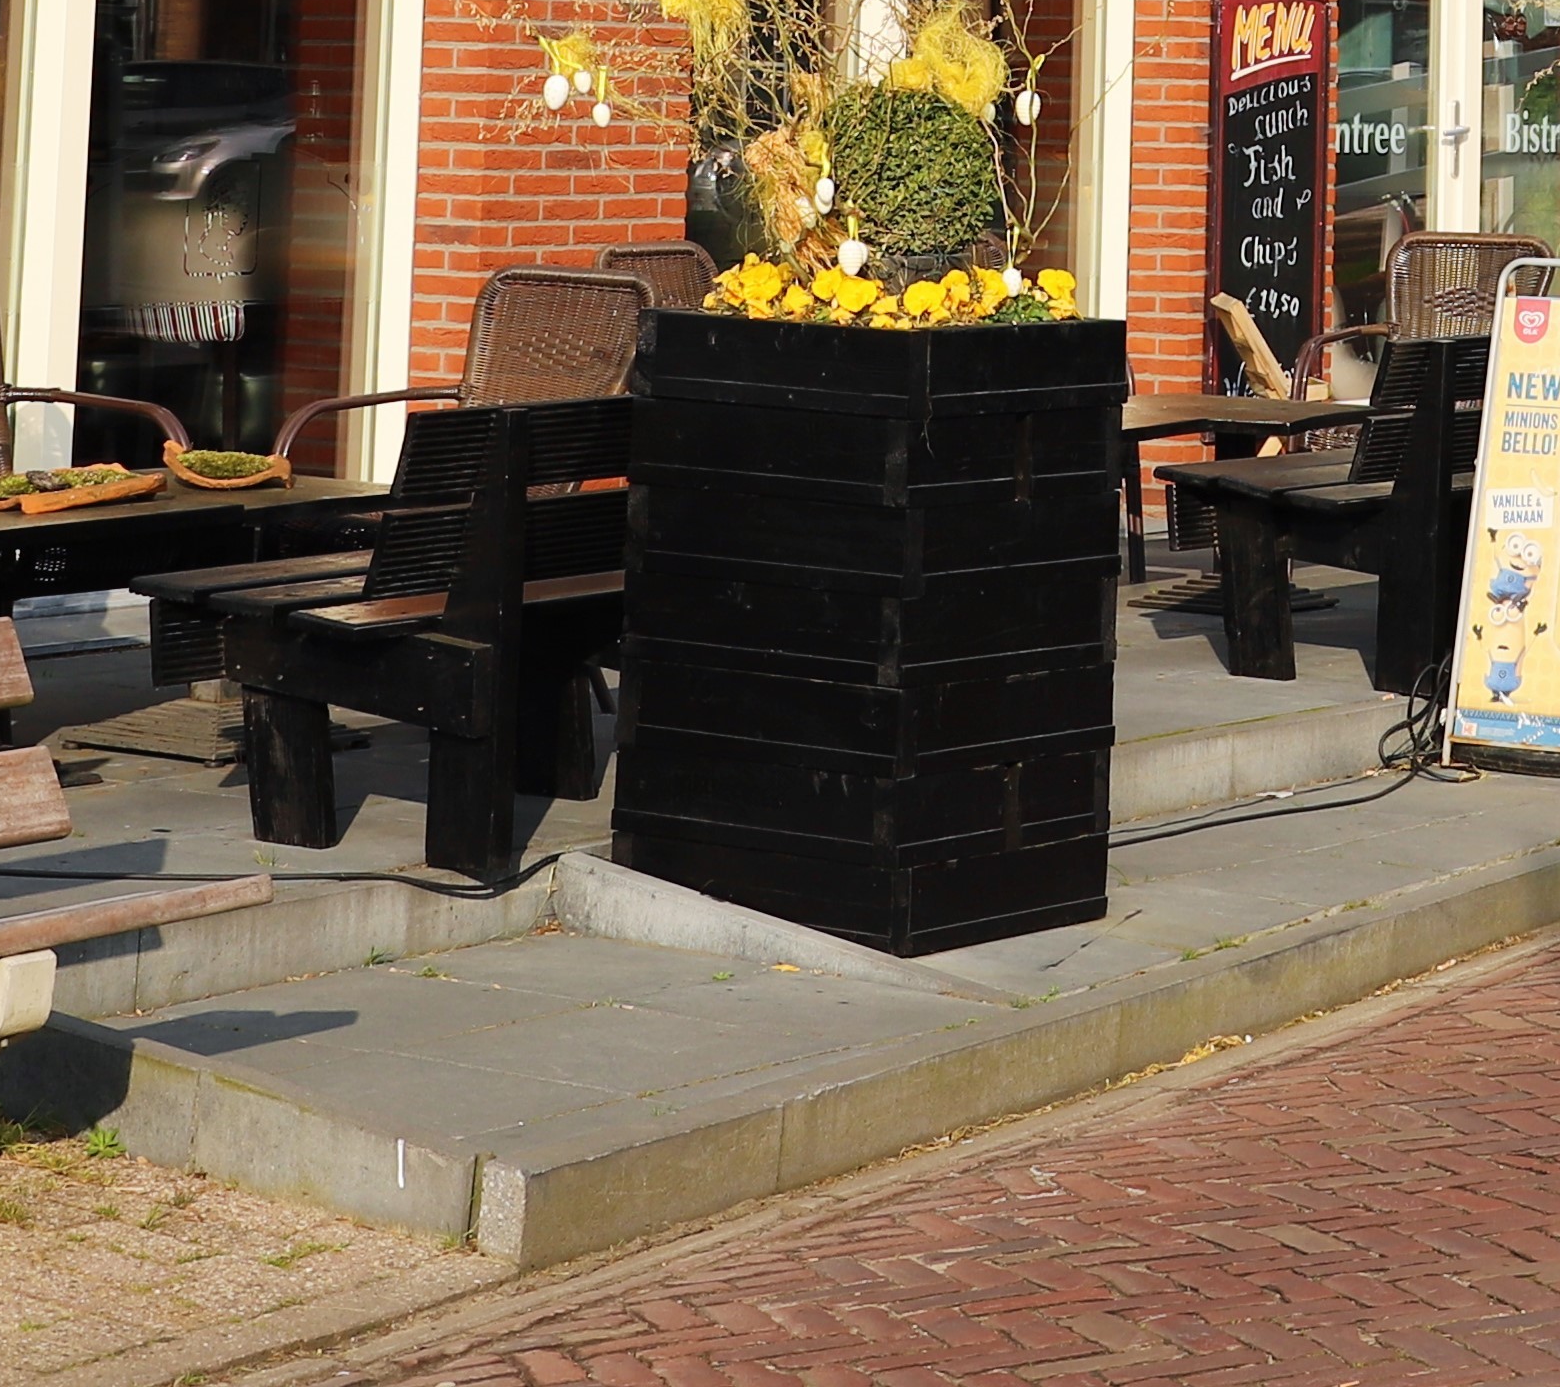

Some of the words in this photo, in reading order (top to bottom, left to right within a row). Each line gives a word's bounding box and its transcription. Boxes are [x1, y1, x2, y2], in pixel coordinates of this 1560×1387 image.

[1232, 1, 1315, 73] MENU
[1336, 112, 1406, 155] ntree
[1242, 144, 1296, 187] Fish
[1252, 187, 1284, 219] and
[1240, 236, 1297, 277] Chips
[1504, 410, 1558, 430] MINIONS
[1501, 431, 1557, 455] BELLO!
[1492, 494, 1532, 508] VANILLE
[1503, 510, 1543, 524] BANAAN
